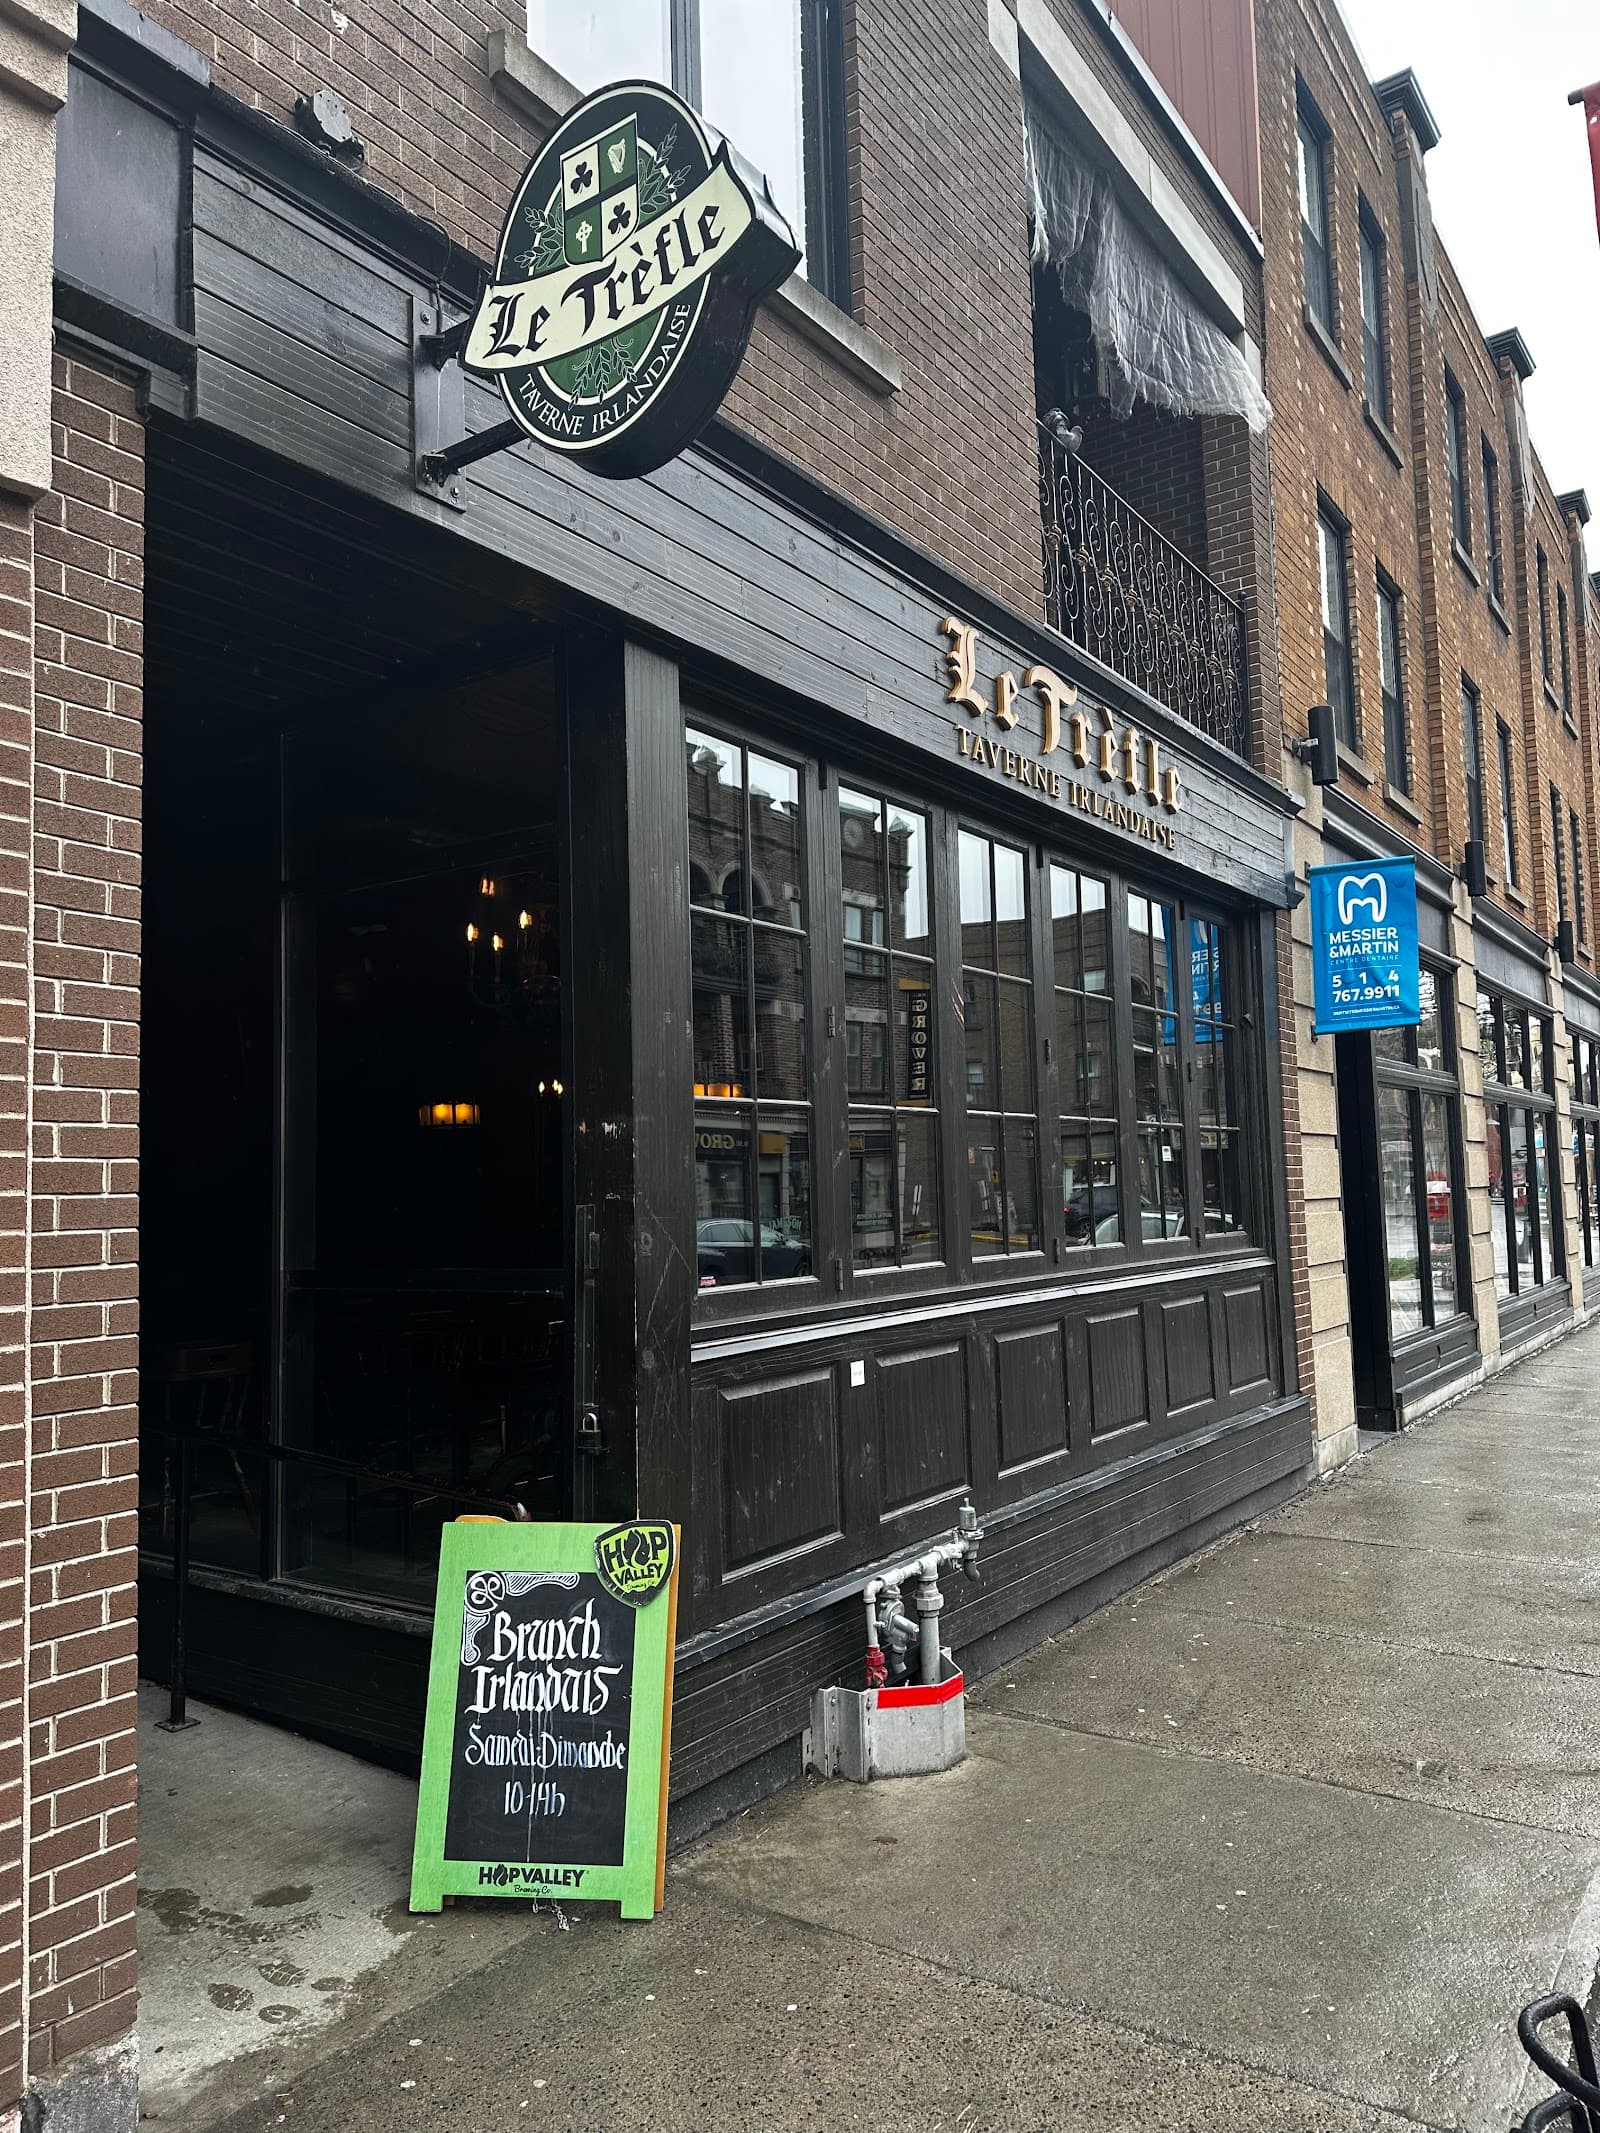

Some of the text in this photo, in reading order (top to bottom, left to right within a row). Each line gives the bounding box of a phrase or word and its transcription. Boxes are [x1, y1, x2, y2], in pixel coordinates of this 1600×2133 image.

[482, 205, 726, 359] Le Trèfle
[518, 304, 691, 436] TAVERNE IRLANDAISE
[941, 616, 1183, 815] Le Trèfle
[954, 724, 1177, 851] TAVERNE IRLANDAISE
[1329, 927, 1399, 945] MESSIER
[1329, 941, 1399, 959] &MARTIN
[1330, 954, 1399, 966] CENTRE DENTAIRE
[1332, 969, 1399, 988] 5 1 4
[1332, 985, 1400, 1003] 767.9911
[603, 1529, 668, 1573] HOP
[614, 1563, 664, 1586] VALLEY
[487, 1598, 602, 1662] Brunch
[464, 1661, 624, 1716] Irlandais
